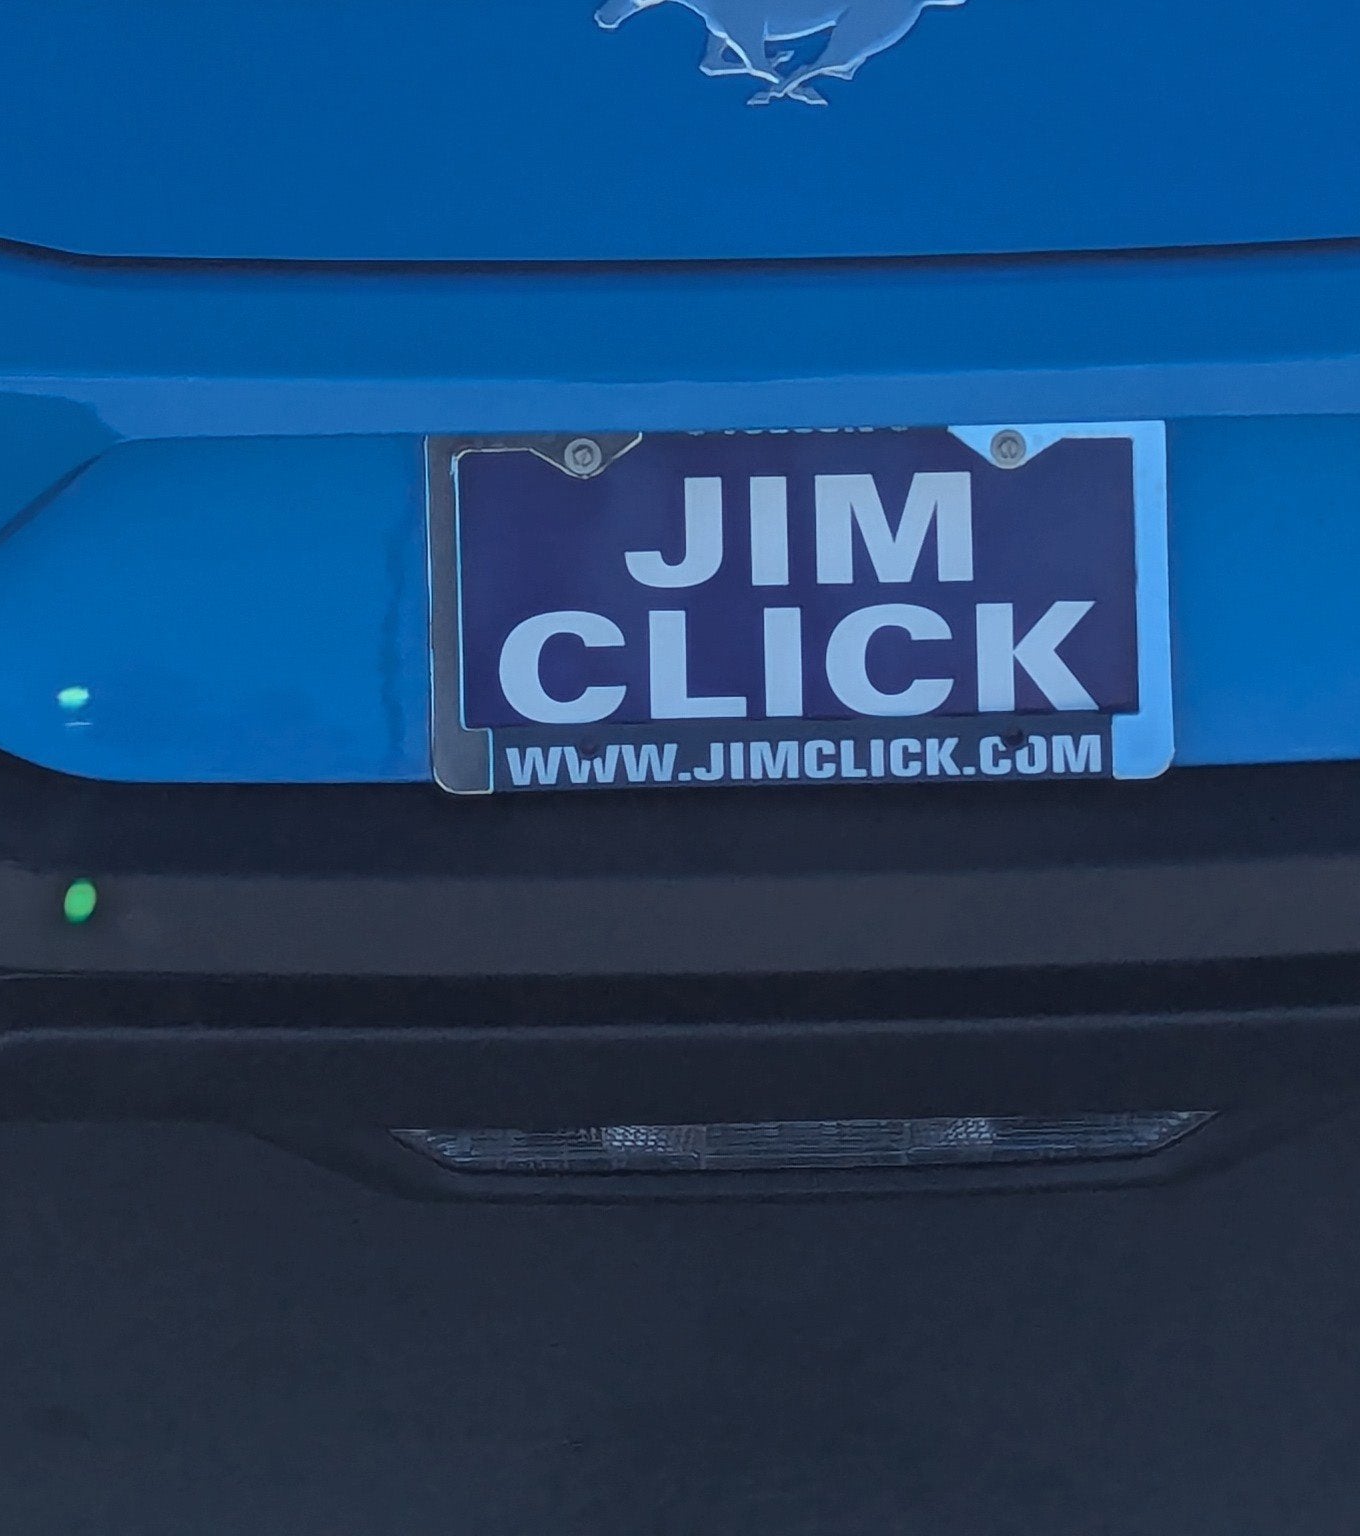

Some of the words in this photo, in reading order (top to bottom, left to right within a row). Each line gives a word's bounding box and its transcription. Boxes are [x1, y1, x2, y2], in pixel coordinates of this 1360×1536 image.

[624, 470, 975, 589] JIM
[498, 600, 1100, 724] CLICK
[505, 733, 1103, 787] WWW.JIMCLICK.COM
